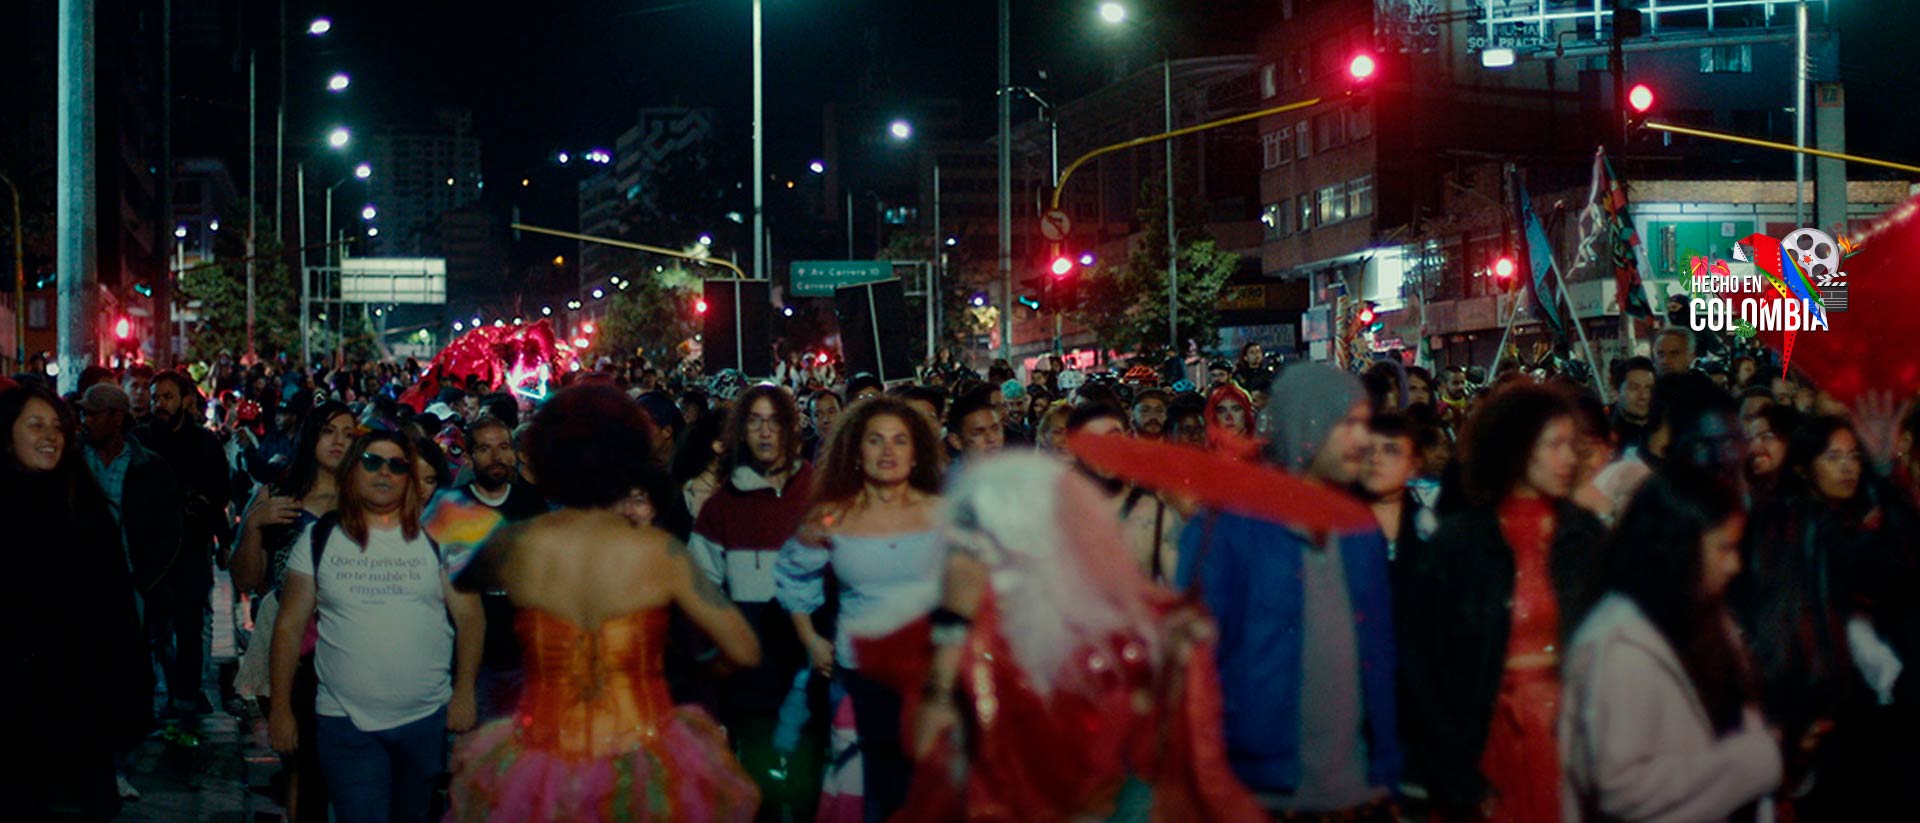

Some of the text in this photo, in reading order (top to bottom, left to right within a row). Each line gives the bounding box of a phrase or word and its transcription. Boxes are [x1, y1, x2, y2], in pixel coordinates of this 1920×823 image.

[828, 268, 866, 276] Carrera
[330, 556, 356, 566] Que
[357, 556, 369, 566] el
[336, 569, 421, 581] no te nuble la
